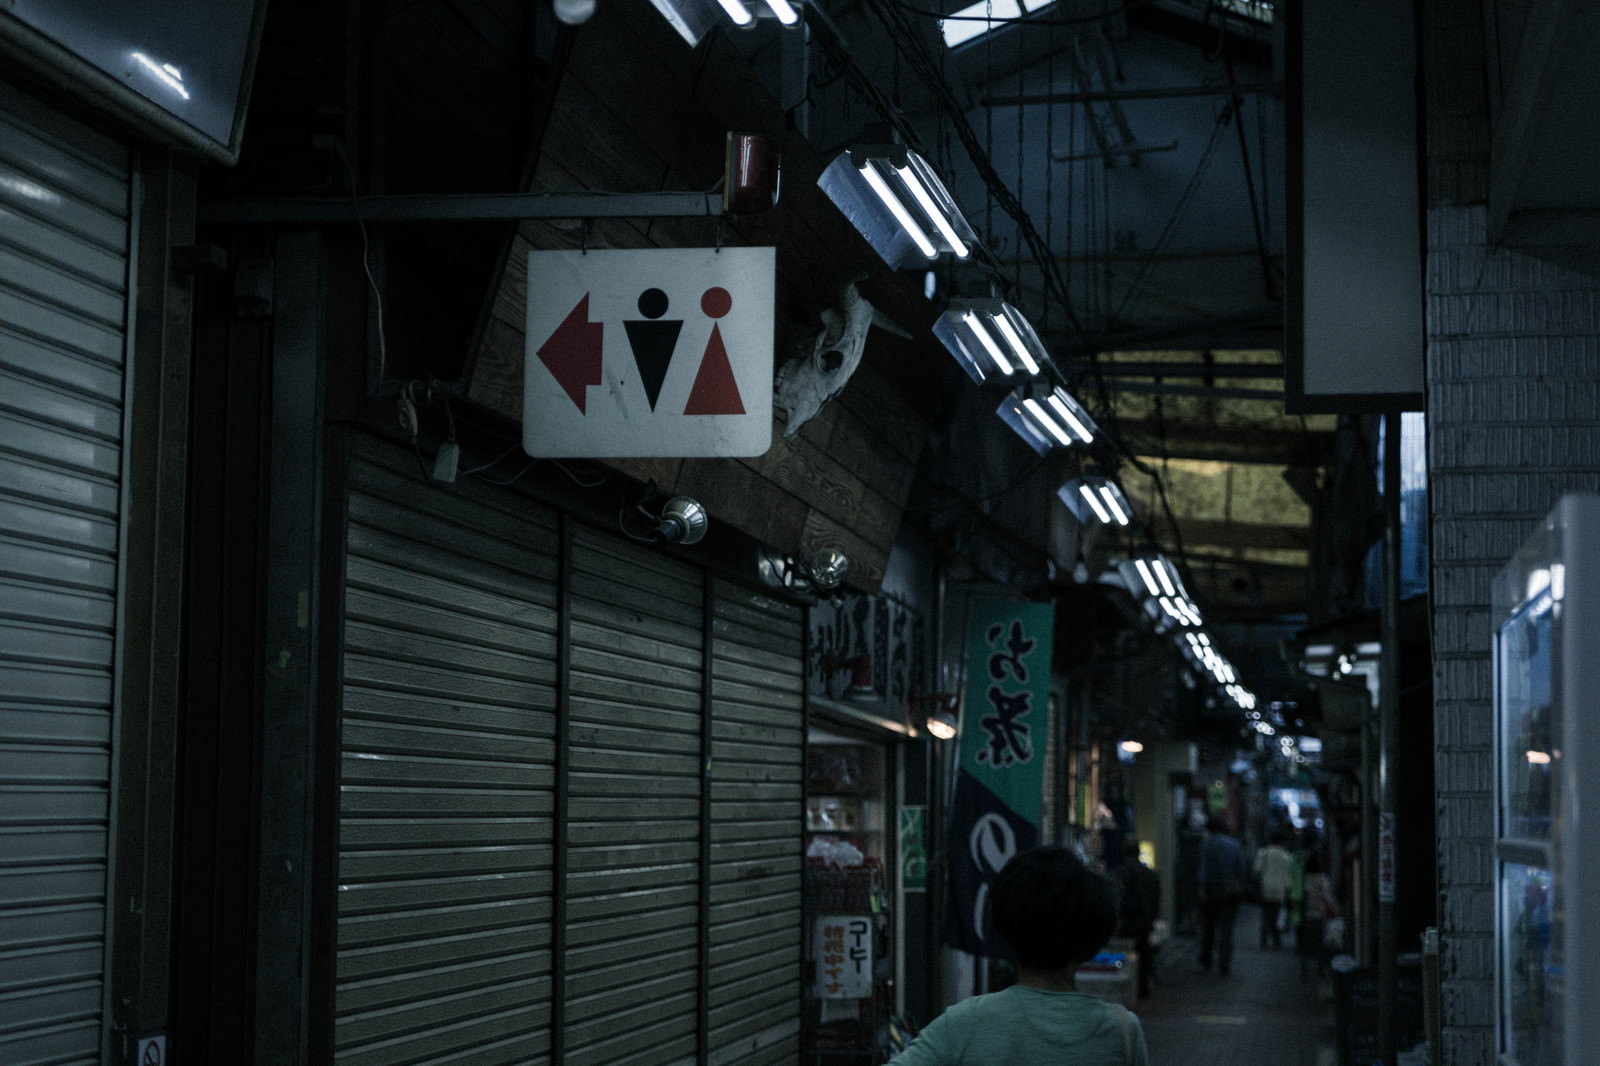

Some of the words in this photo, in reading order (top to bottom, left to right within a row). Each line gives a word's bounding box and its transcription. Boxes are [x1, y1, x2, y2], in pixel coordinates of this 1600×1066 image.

[968, 620, 1035, 943] お茶の
[849, 920, 868, 974] コーヒー
